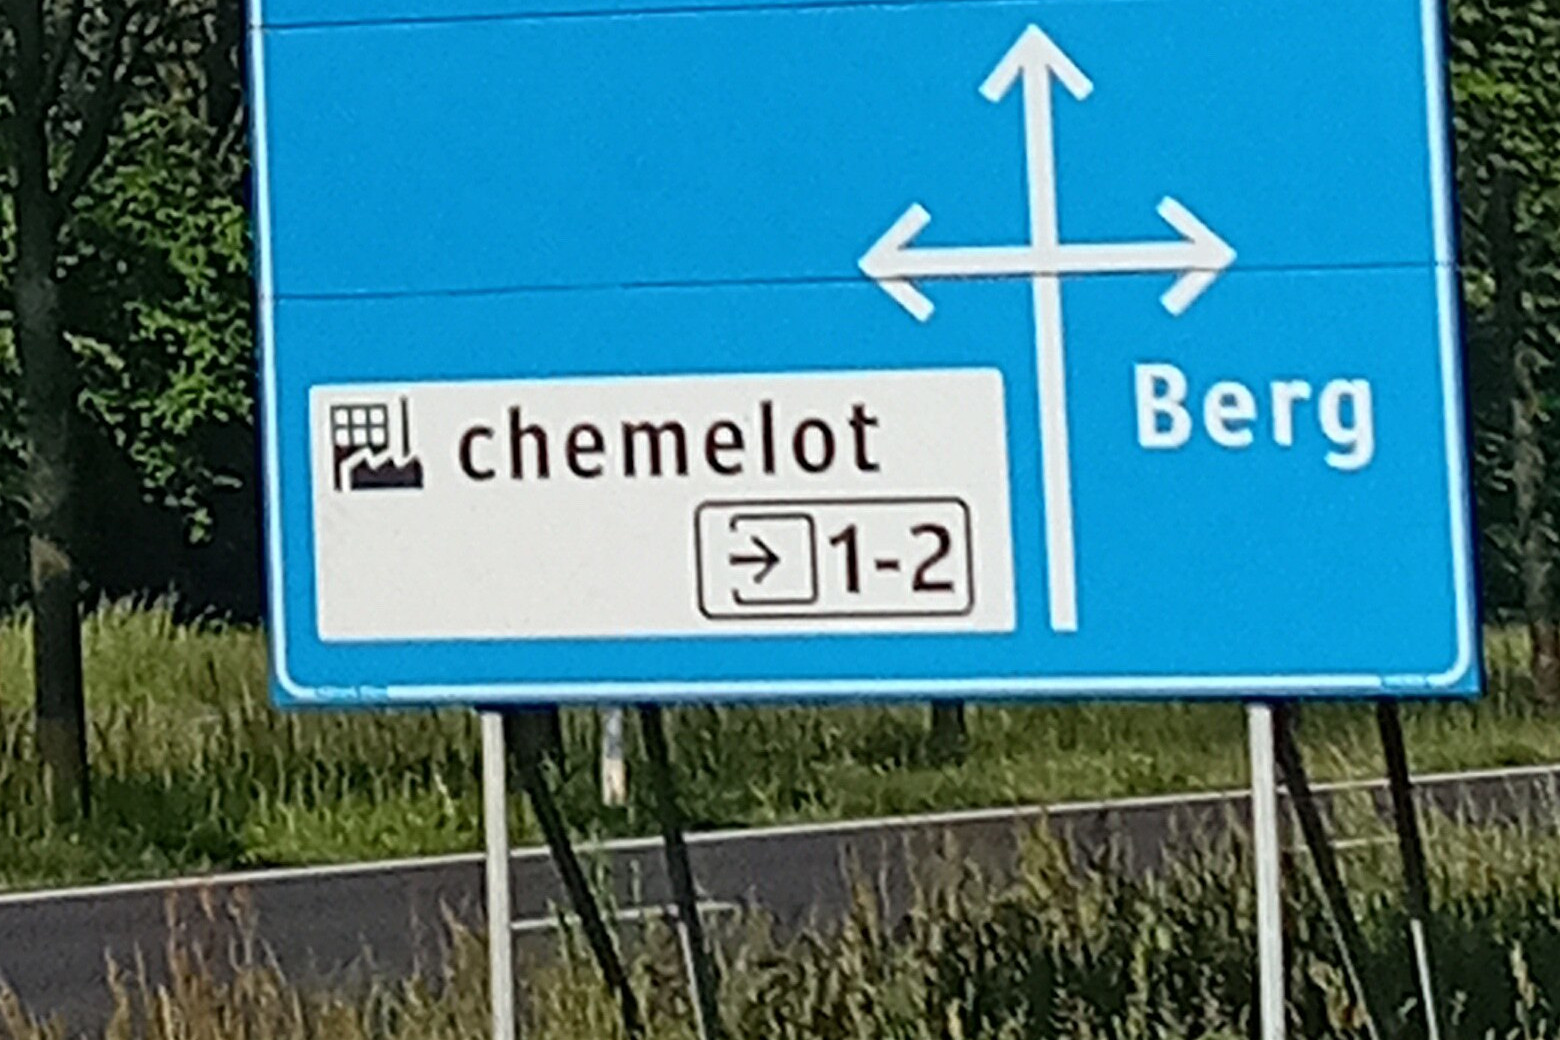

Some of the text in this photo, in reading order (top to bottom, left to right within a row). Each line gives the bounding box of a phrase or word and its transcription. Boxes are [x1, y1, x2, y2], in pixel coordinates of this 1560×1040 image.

[458, 399, 881, 482] chemelot
[1134, 362, 1375, 471] Berg
[828, 522, 955, 595] 1-2
